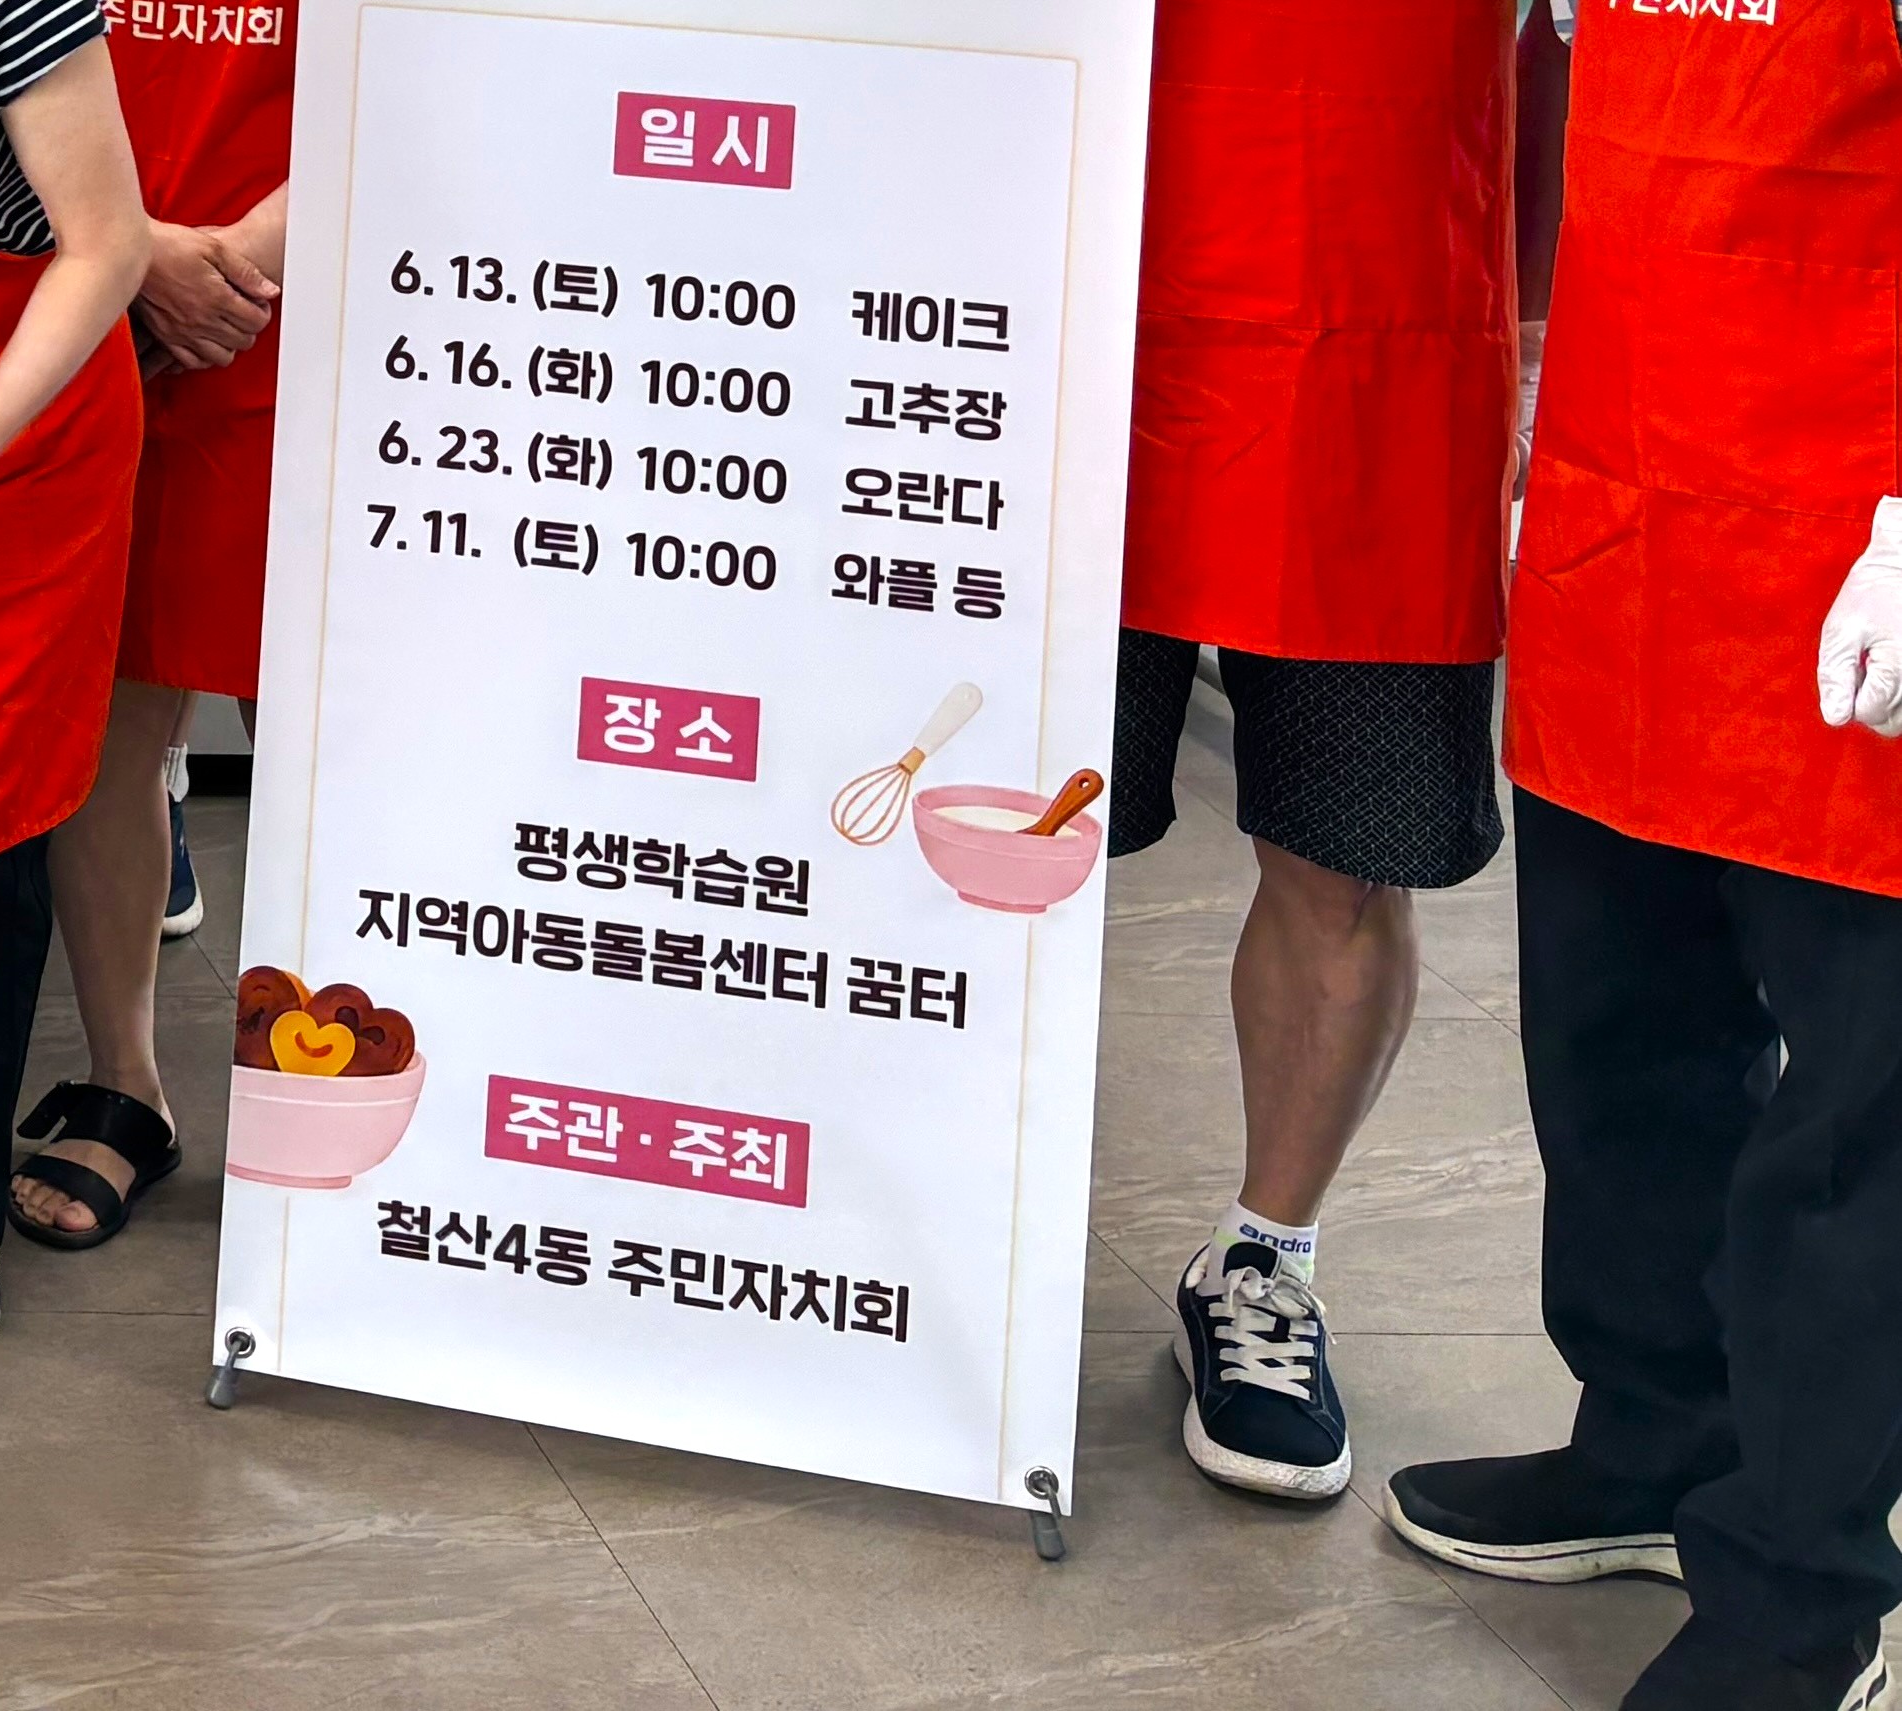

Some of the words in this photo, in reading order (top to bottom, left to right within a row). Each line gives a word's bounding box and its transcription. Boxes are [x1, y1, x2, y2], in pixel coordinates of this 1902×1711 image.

[532, 259, 619, 319] (토)
[645, 272, 797, 331] 10:00
[850, 289, 1011, 353] 케이크
[527, 344, 614, 405] (화)
[640, 359, 792, 418] 10:00
[844, 378, 1008, 442] 고추장
[526, 431, 614, 492] (화)
[635, 446, 788, 505] 10:00
[841, 468, 1006, 532] 오란다
[513, 517, 600, 577] (토)
[625, 532, 778, 592] 10:00
[831, 552, 939, 613] 와플
[951, 565, 1007, 620] 등
[513, 822, 811, 918] 평생학습원
[355, 888, 830, 1010] 지역아동돌봄센터
[845, 955, 968, 1030] 꿈터
[504, 1092, 625, 1164] 주관
[668, 1118, 789, 1192] 주최
[377, 1199, 592, 1287] 철산4동
[606, 1238, 911, 1344] 주민자치회
[1239, 1222, 1312, 1254] andro
